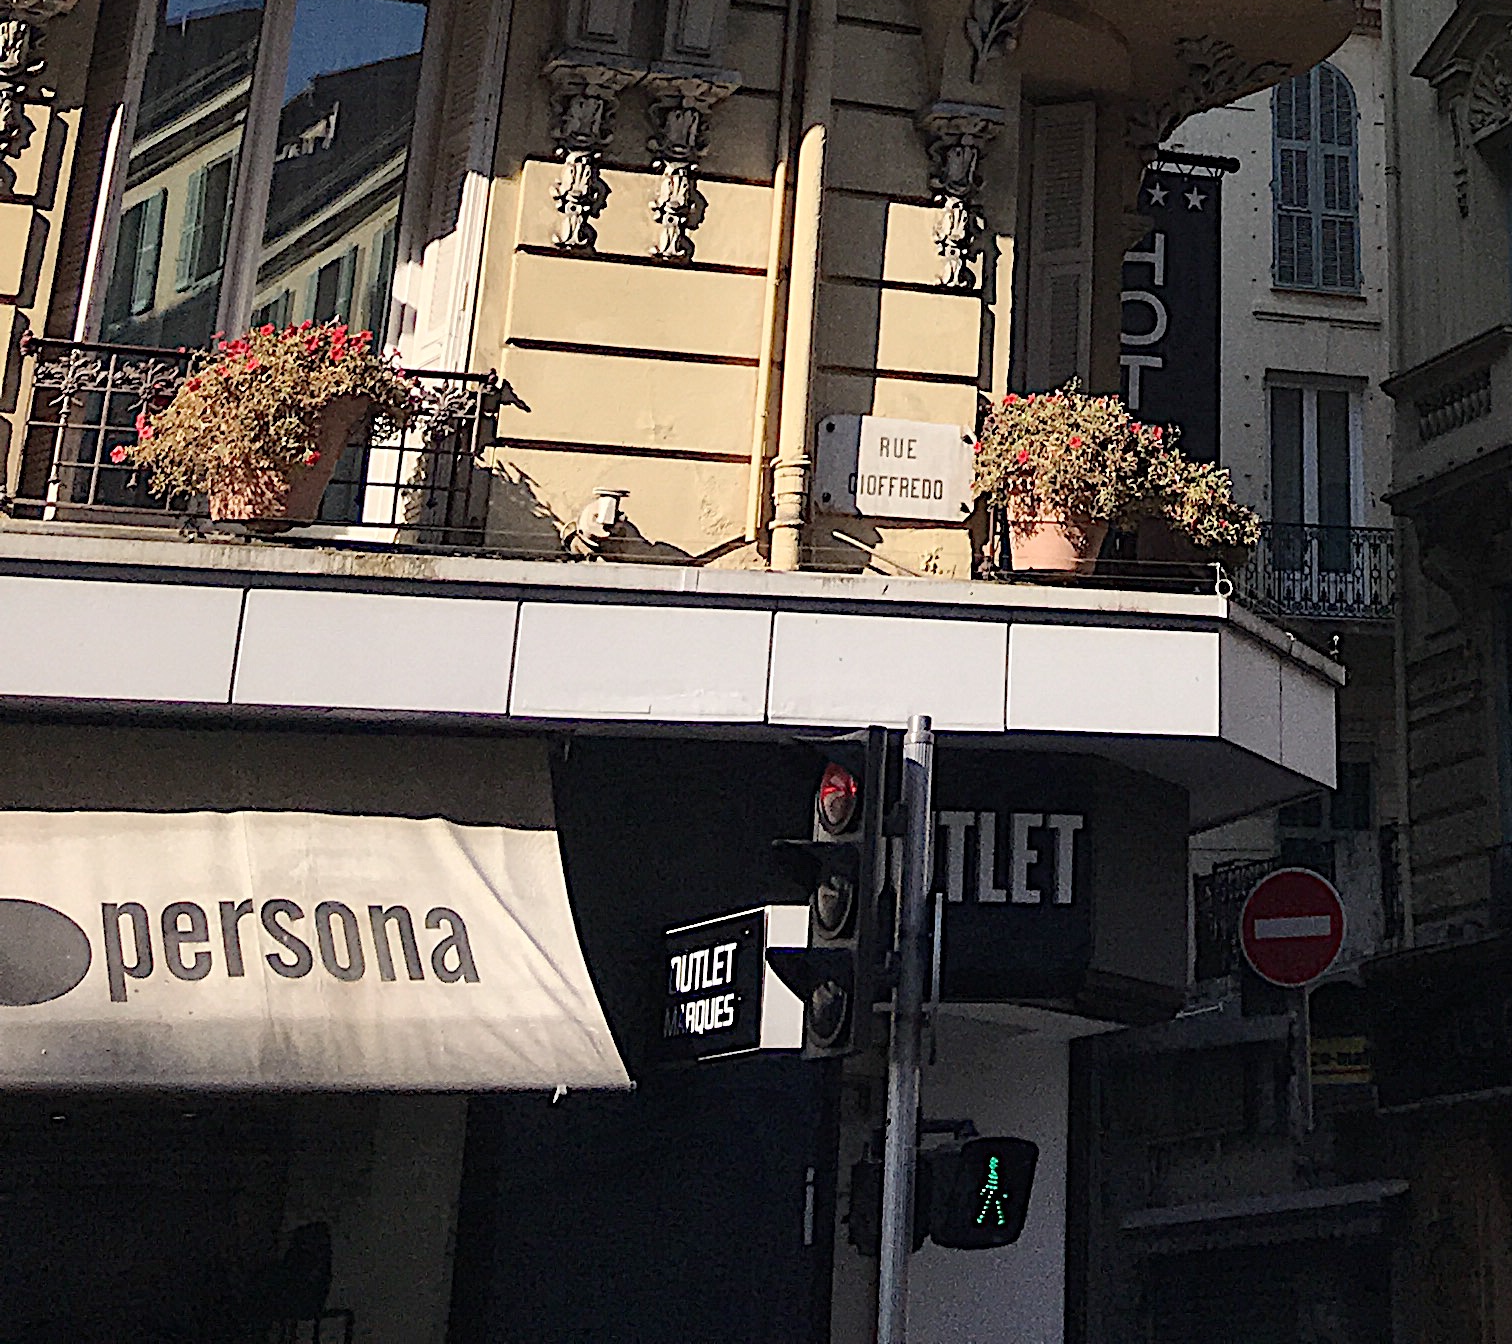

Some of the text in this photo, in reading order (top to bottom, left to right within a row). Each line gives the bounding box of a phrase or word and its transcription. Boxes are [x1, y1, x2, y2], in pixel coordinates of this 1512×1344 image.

[880, 437, 918, 460] RUE
[101, 898, 481, 1003] persona
[669, 942, 738, 995] OUTLET
